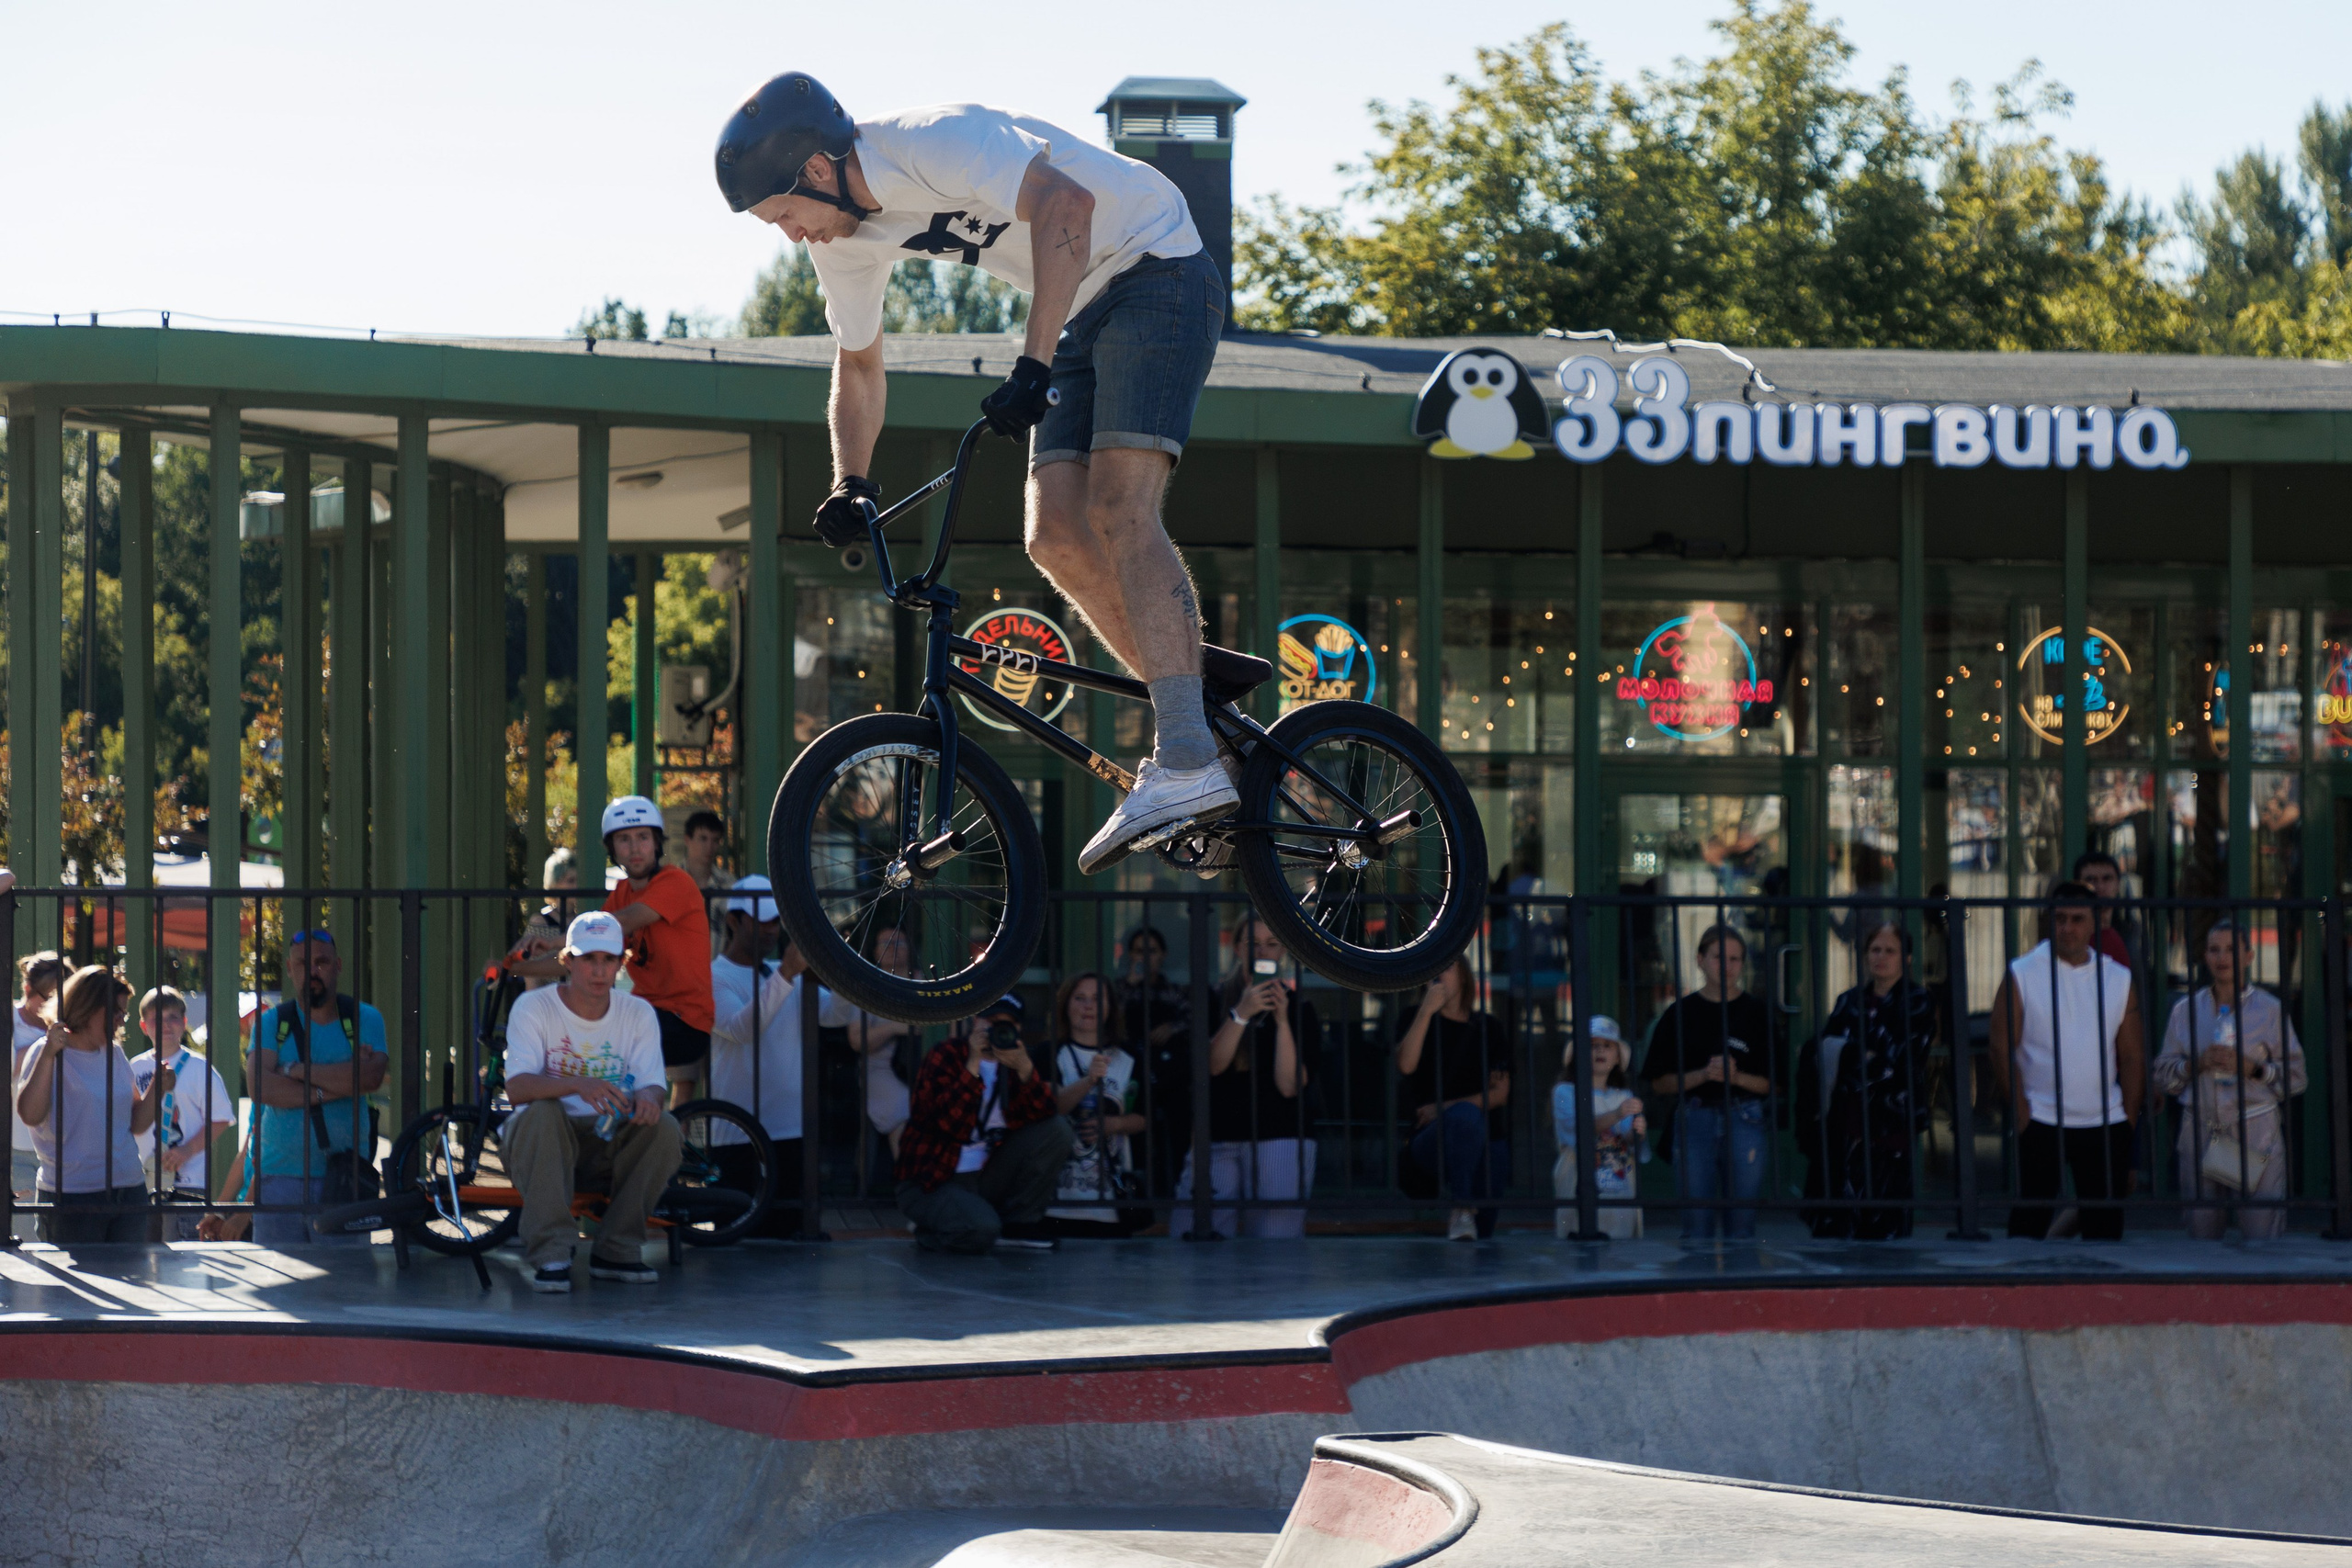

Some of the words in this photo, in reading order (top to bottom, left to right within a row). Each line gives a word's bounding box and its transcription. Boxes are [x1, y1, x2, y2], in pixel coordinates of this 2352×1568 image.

[1616, 676, 1774, 703] МОЛОЧНАЯ
[1649, 702, 1740, 726] КУХНЯ
[916, 982, 974, 998] MAXXIS
